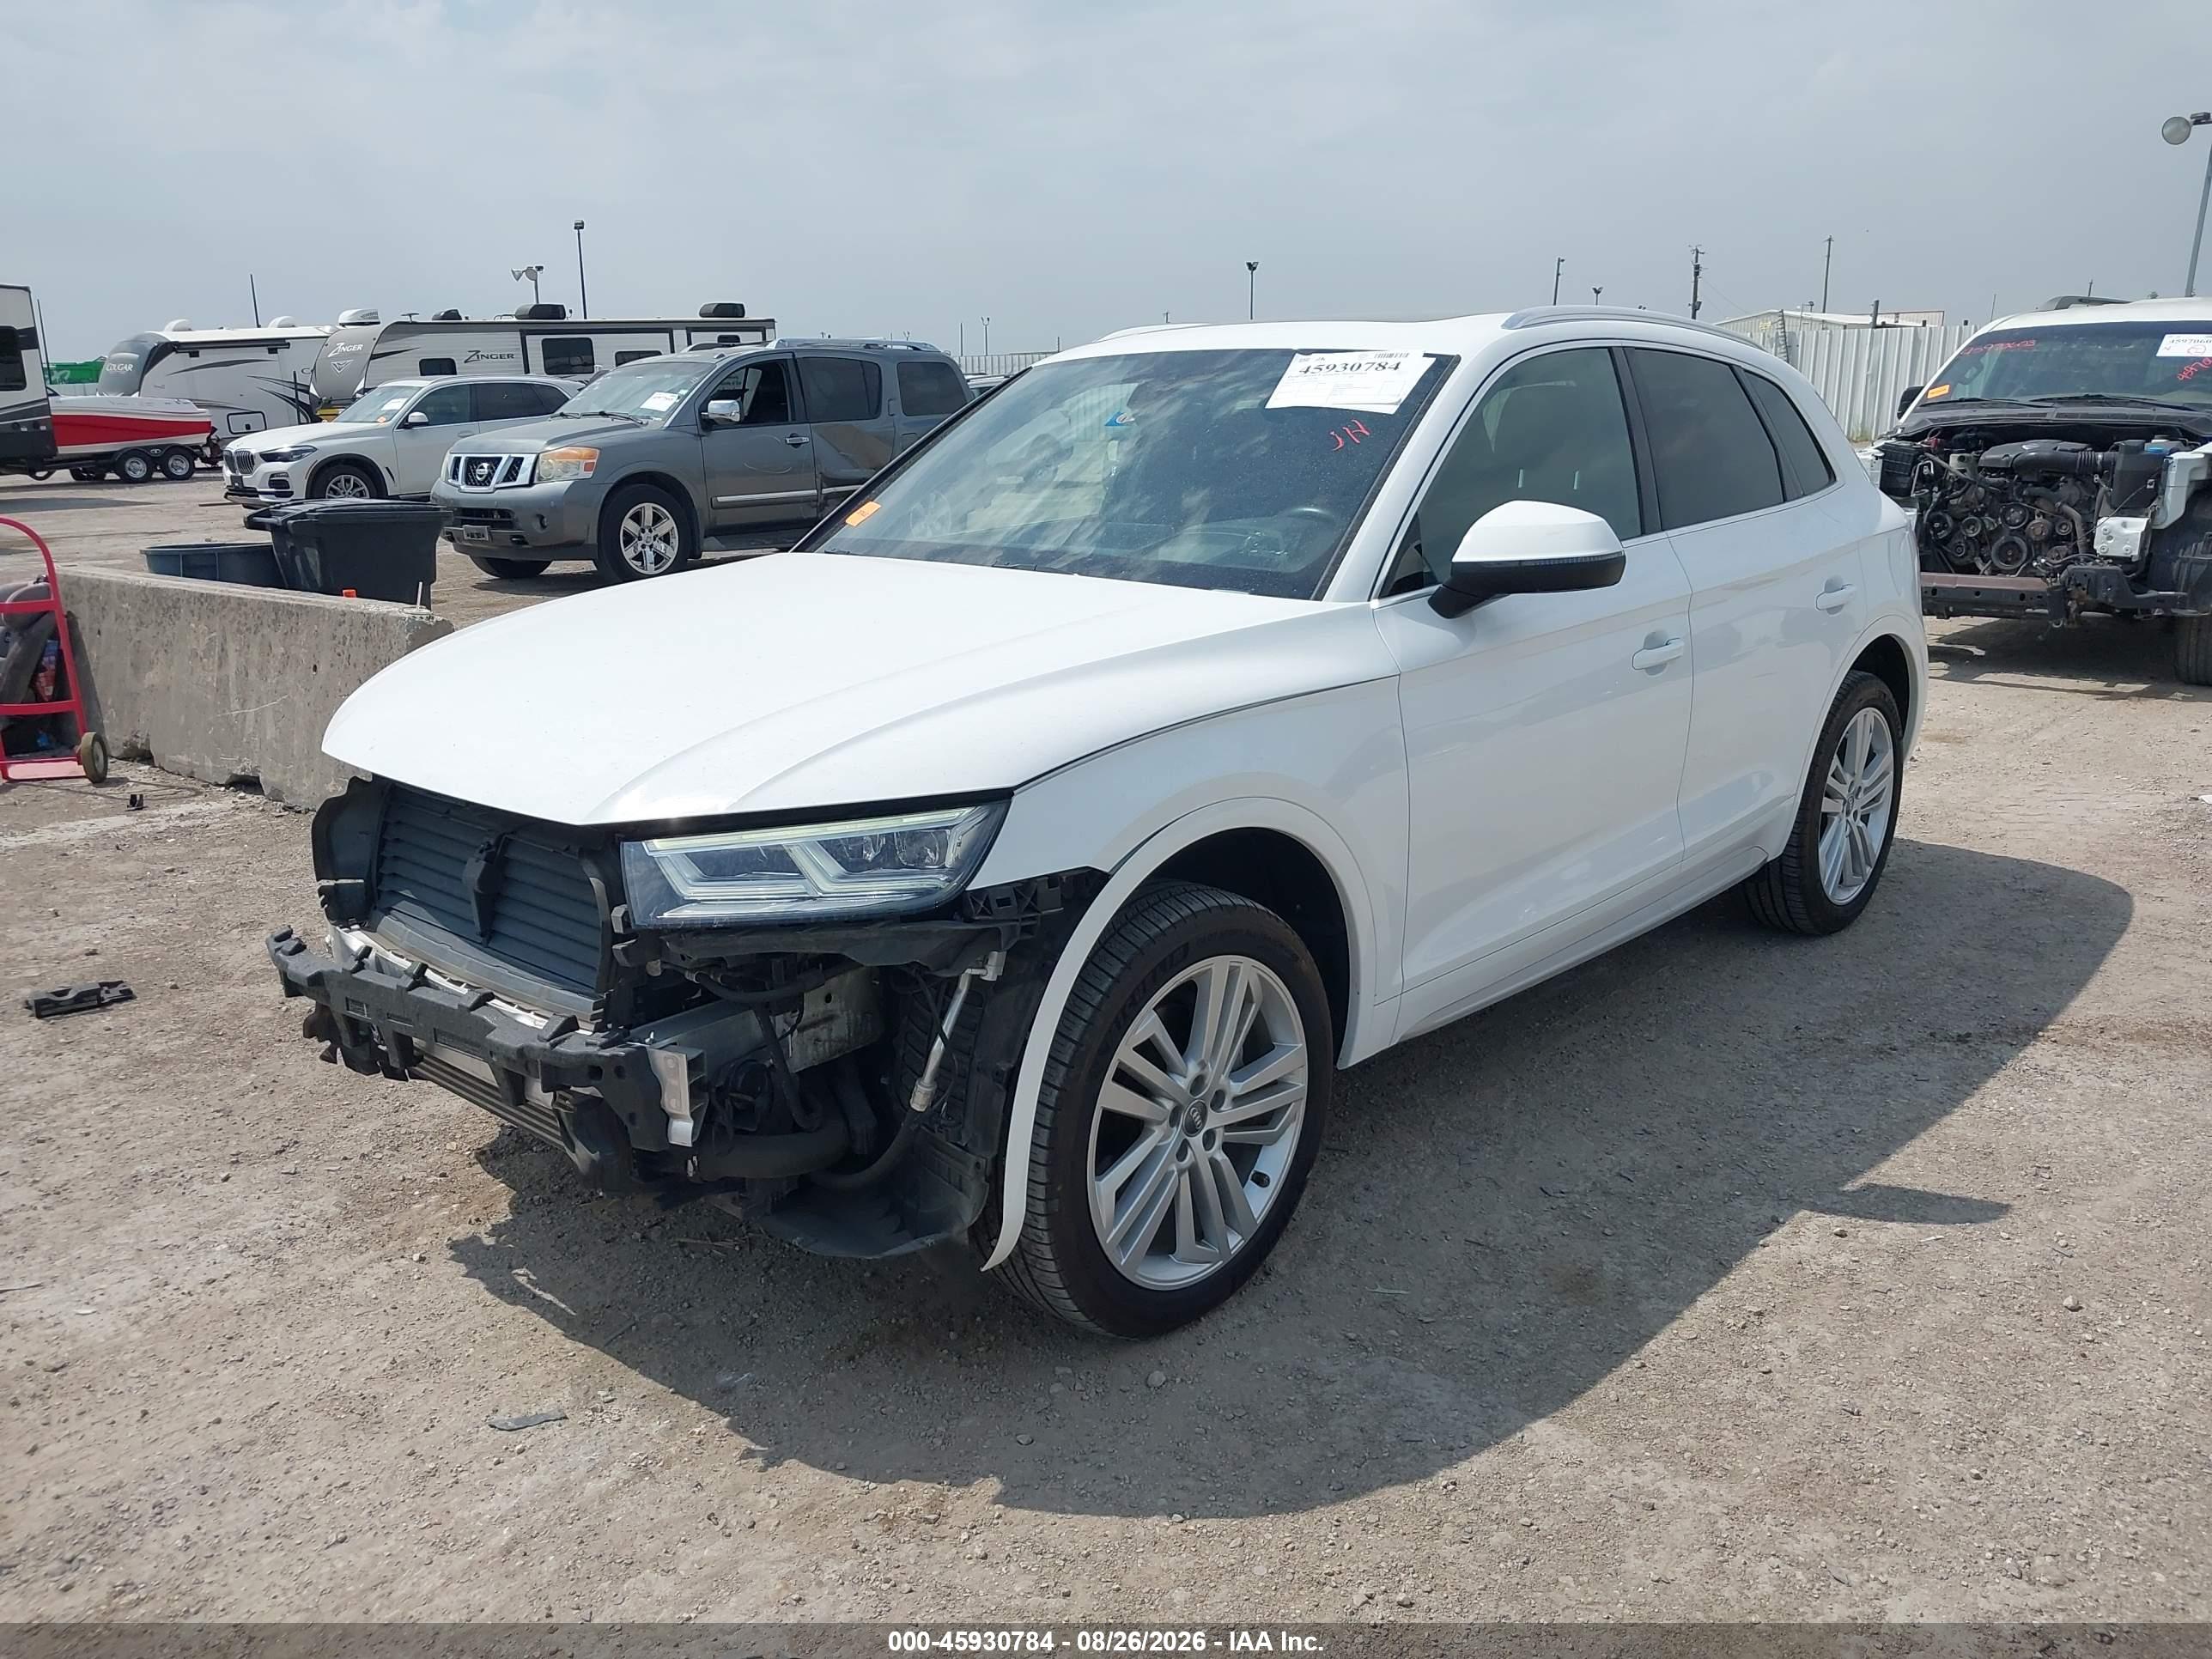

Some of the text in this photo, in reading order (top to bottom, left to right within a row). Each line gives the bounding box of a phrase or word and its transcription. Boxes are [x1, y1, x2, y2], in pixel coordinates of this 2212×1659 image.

[327, 342, 363, 357] ZINGER
[464, 349, 515, 363] ZINGER
[1298, 361, 1401, 374] 45930784
